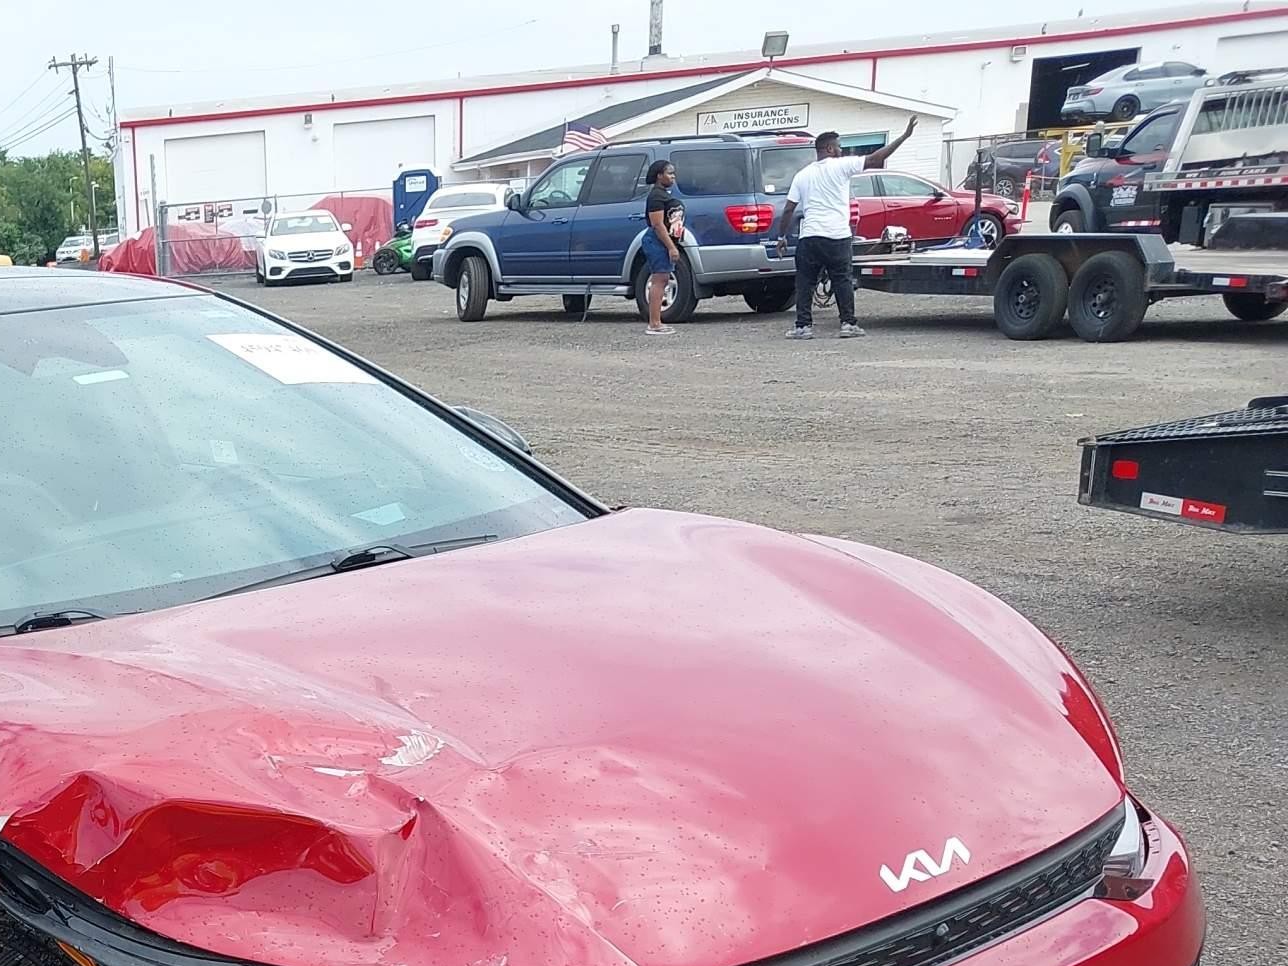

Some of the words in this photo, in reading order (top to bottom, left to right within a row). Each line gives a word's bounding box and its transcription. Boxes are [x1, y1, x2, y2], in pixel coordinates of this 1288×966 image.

[734, 108, 789, 120] INSURANCE
[723, 121, 748, 129] AUTO
[752, 116, 799, 127] AUCTIONS
[879, 836, 972, 894] KIA
